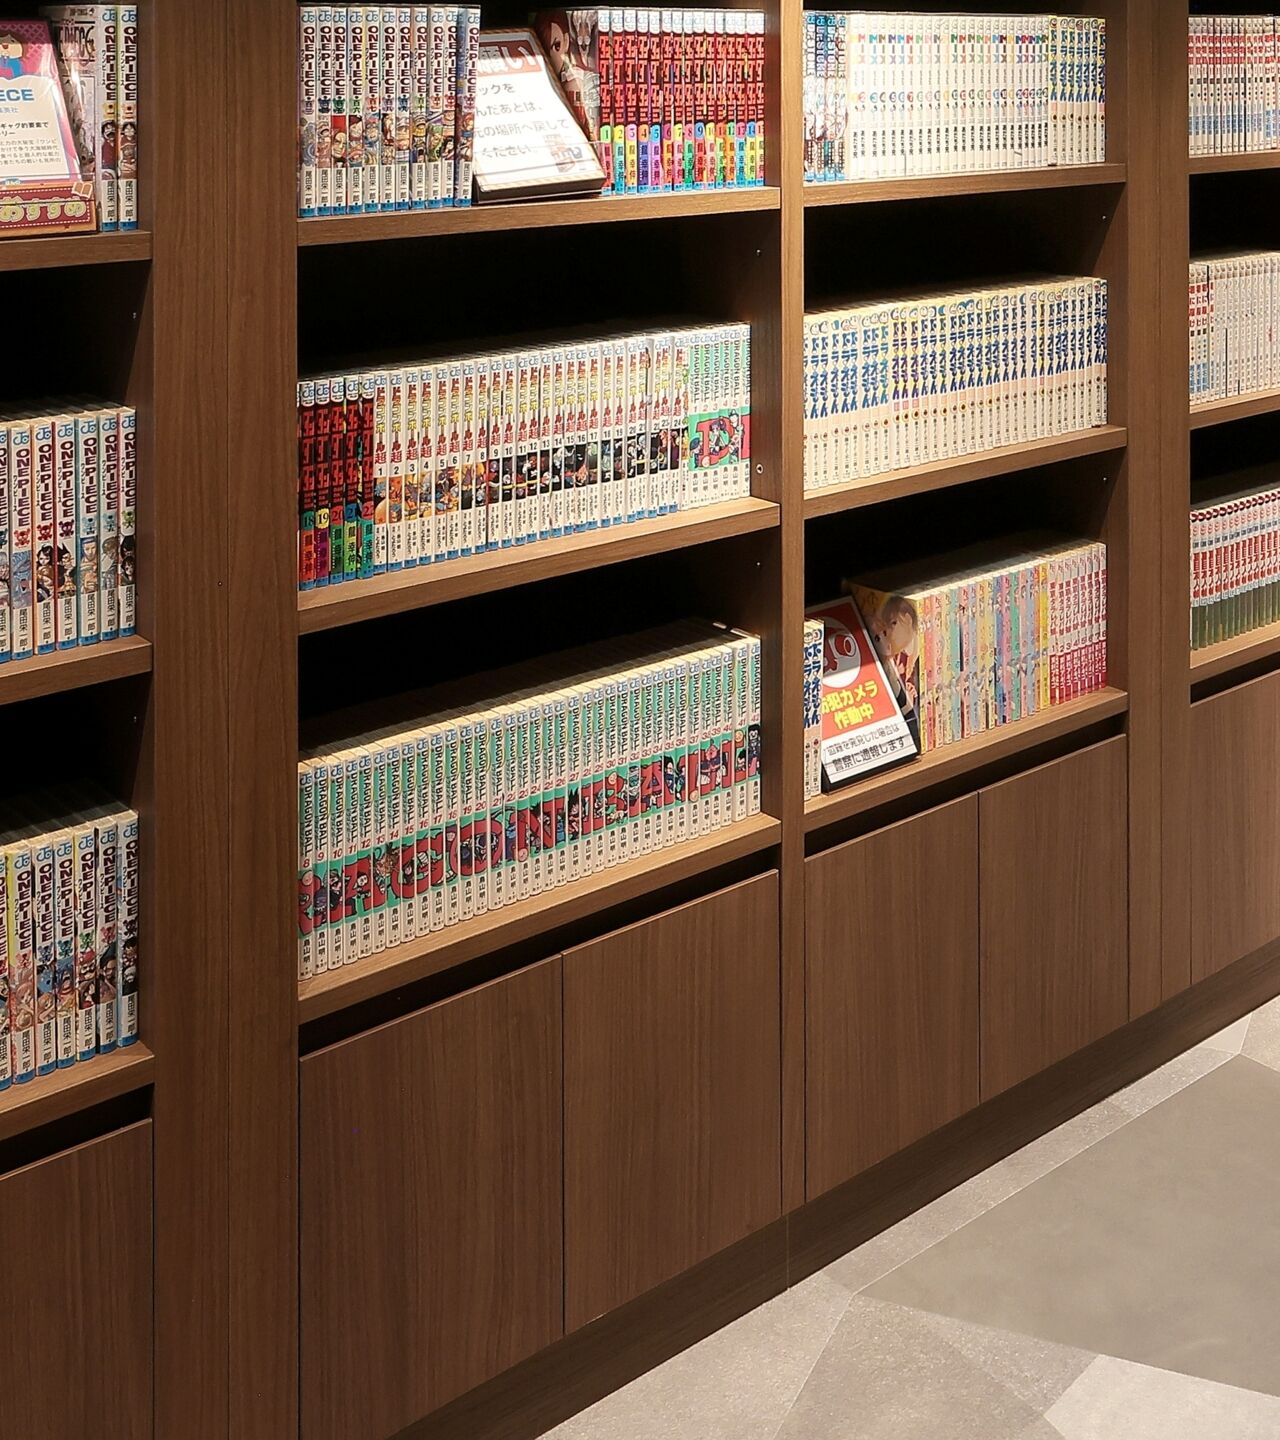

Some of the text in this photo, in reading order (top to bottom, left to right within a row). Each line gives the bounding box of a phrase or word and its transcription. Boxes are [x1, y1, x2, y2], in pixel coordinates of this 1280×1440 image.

[375, 387, 386, 464] ドラゴンボール超
[406, 384, 417, 461] ドラゴンボール超
[834, 702, 875, 730] 作動中
[361, 838, 371, 849] 12
